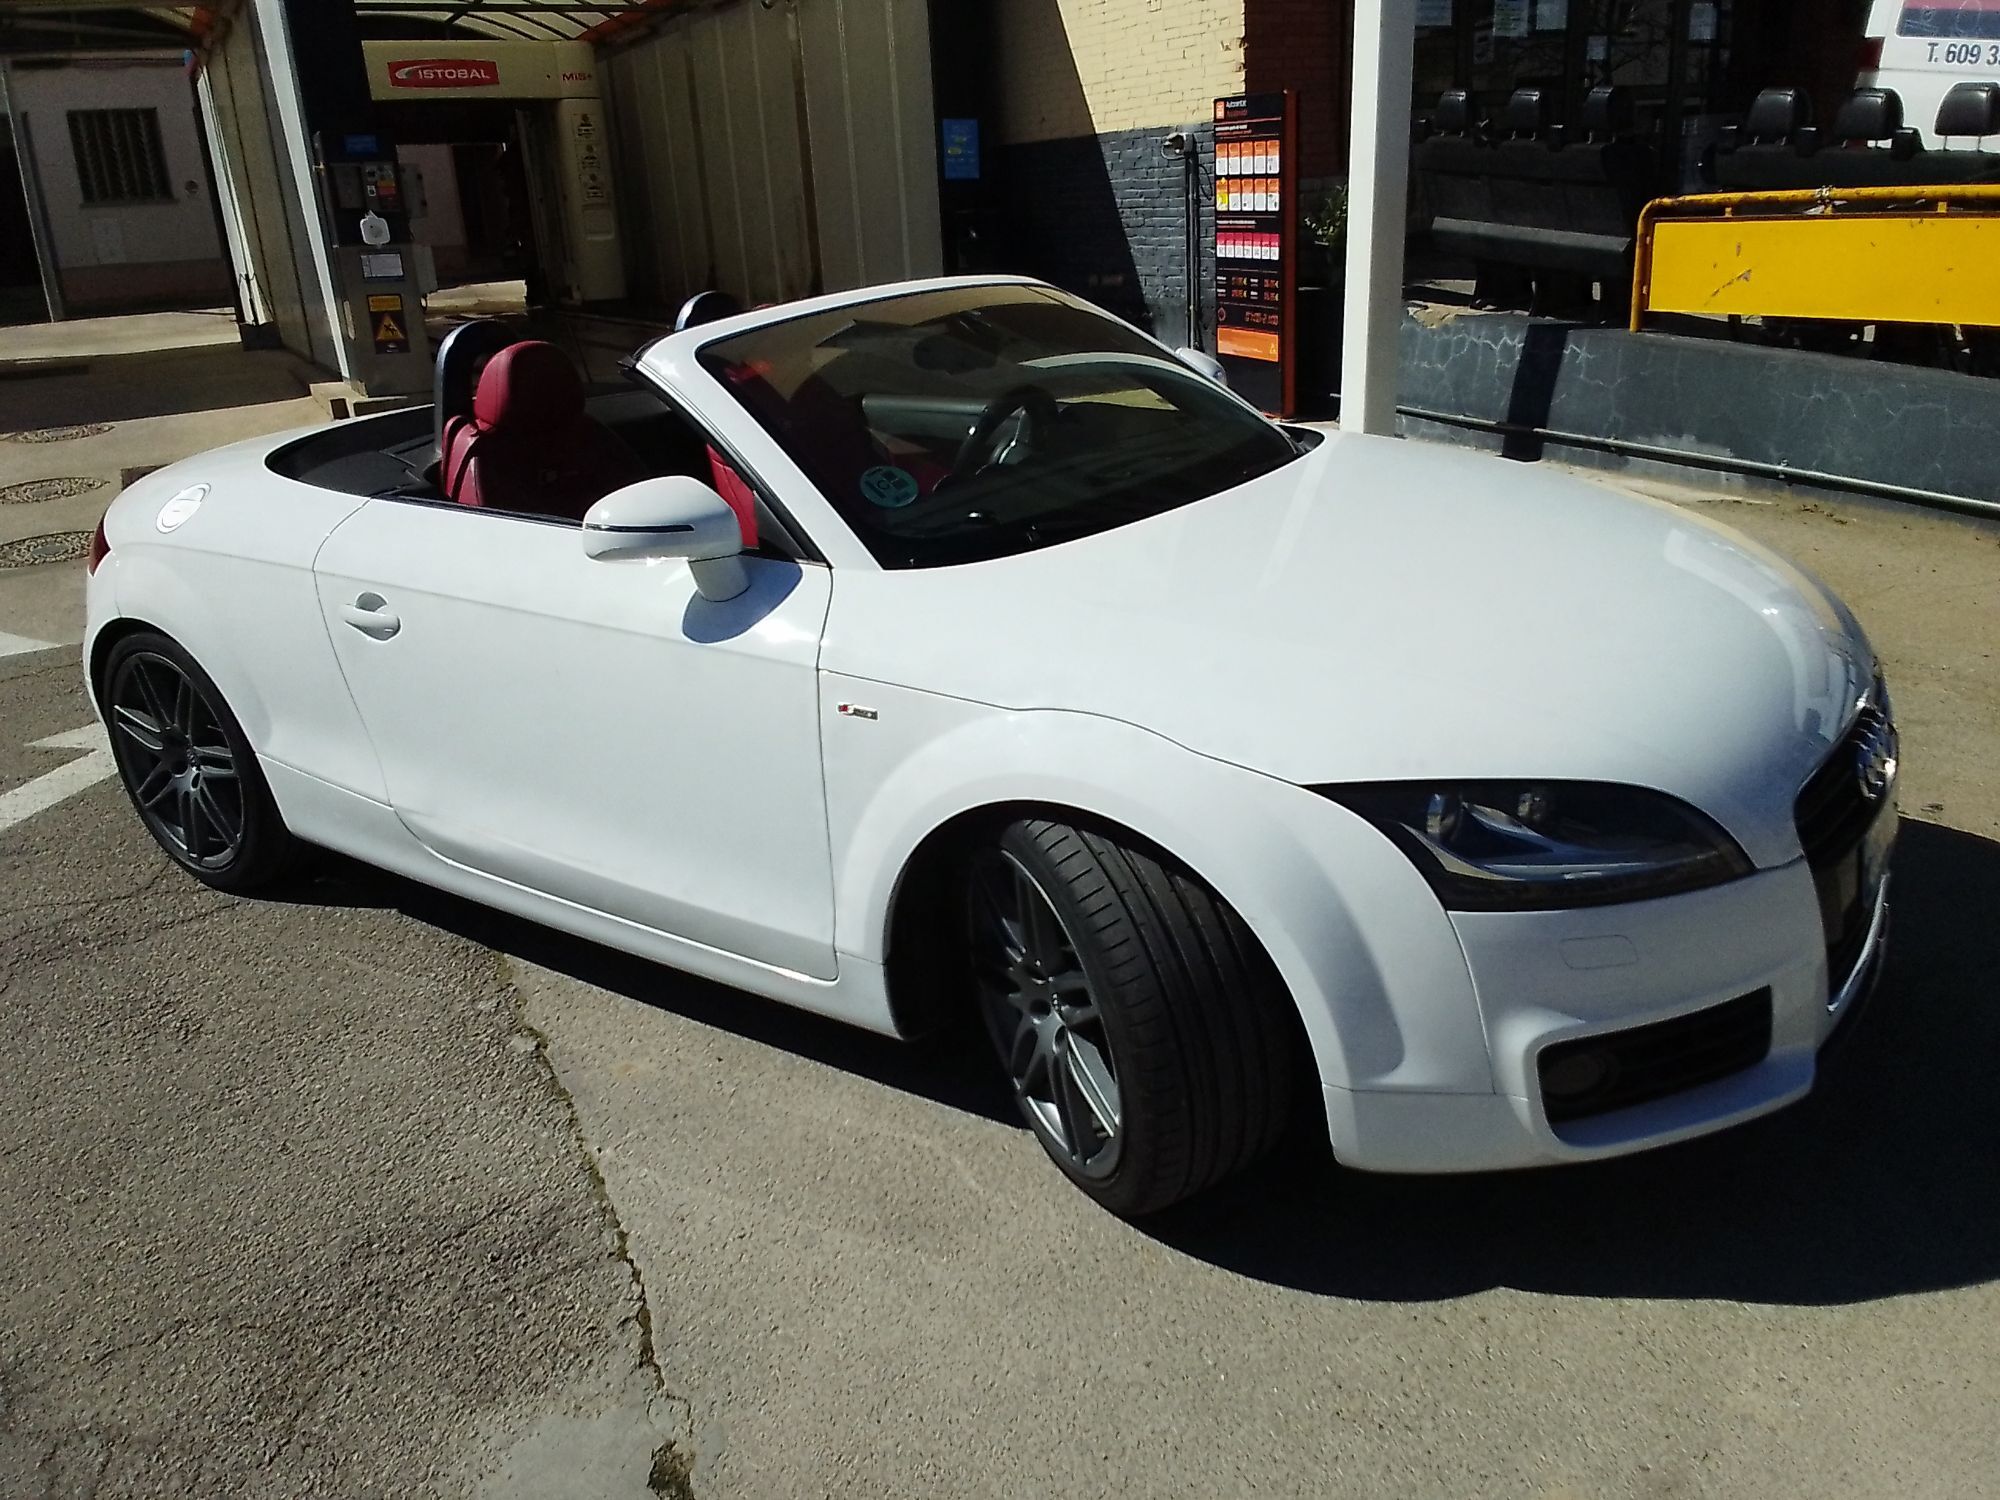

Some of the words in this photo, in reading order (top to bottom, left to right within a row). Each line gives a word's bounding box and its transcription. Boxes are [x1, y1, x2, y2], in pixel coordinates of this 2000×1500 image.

[1927, 42, 1939, 62] T.
[1945, 43, 1981, 64] 609
[1986, 45, 2000, 65] 3
[418, 68, 491, 79] ISTOBAL
